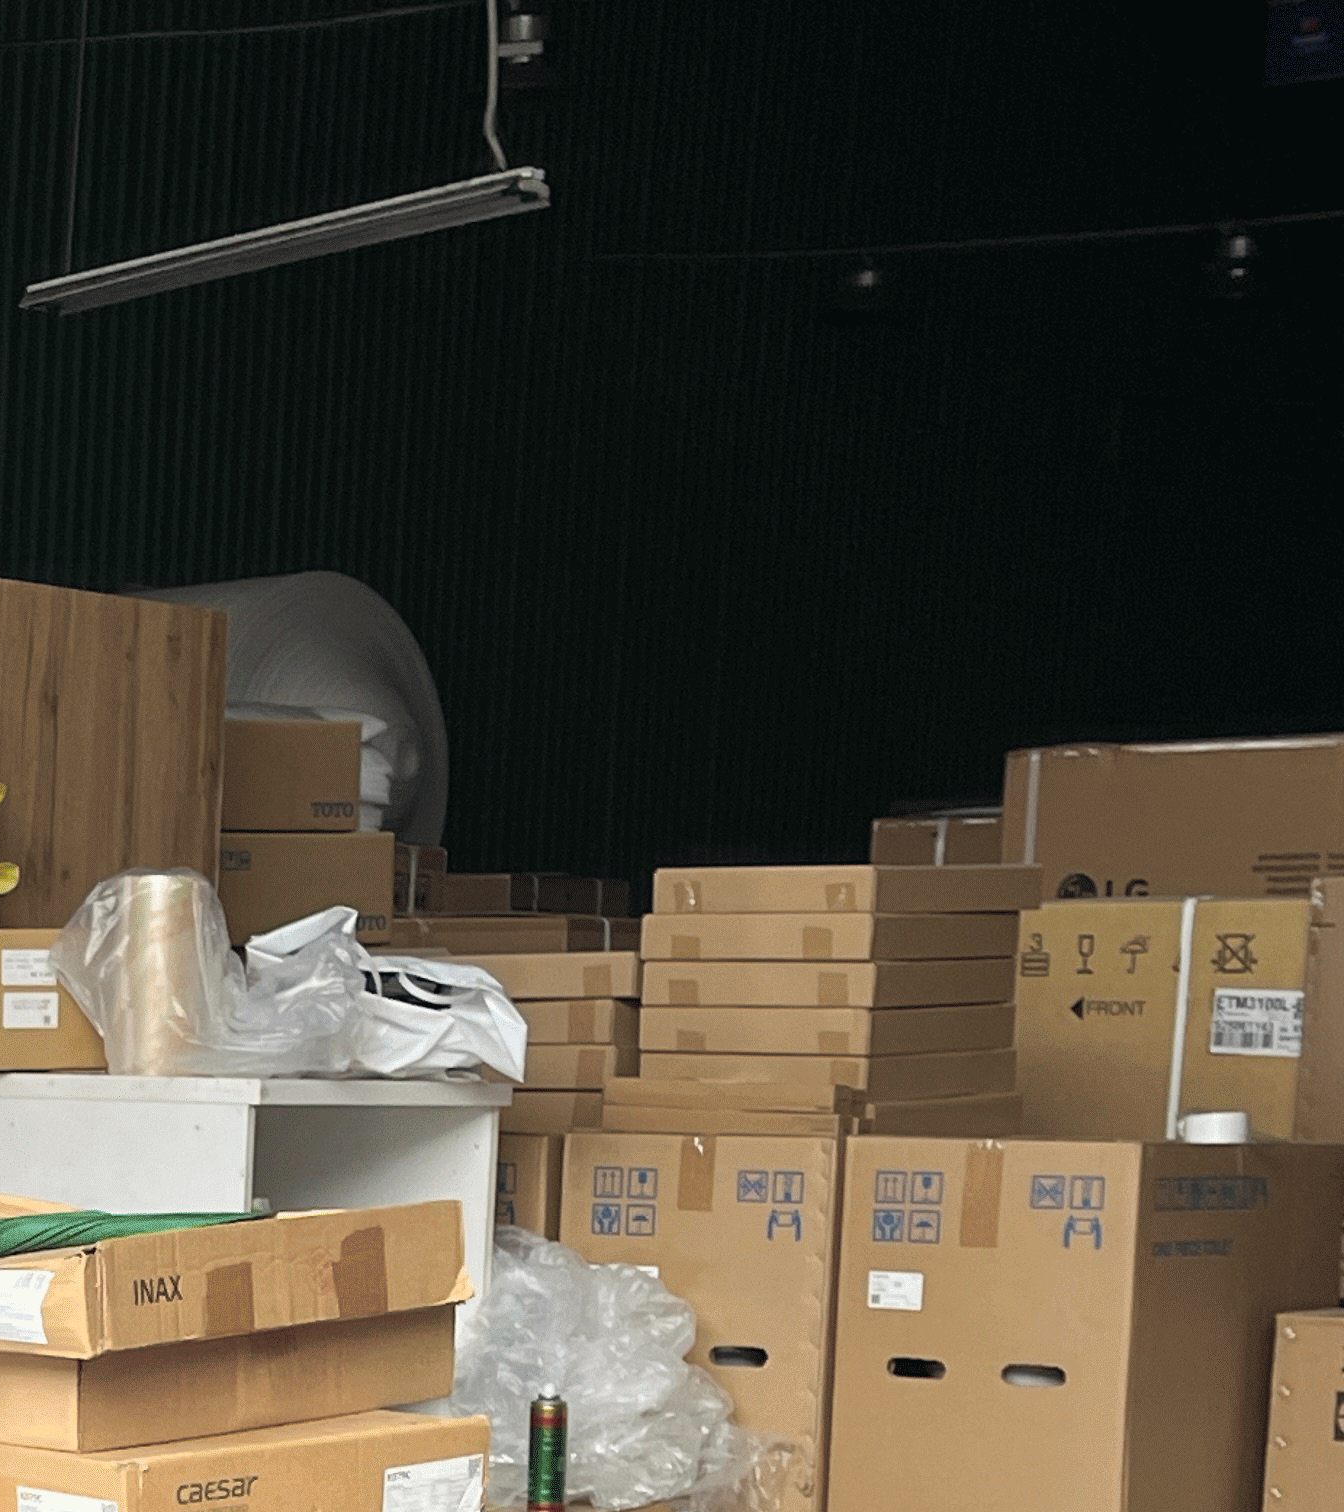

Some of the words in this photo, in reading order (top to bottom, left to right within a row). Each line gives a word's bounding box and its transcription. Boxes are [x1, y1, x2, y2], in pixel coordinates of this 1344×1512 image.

[310, 801, 355, 819] TOTO
[354, 914, 387, 932] OTO
[1085, 999, 1148, 1018] FRONT
[132, 1272, 184, 1307] INAX
[175, 1475, 259, 1506] caesar
